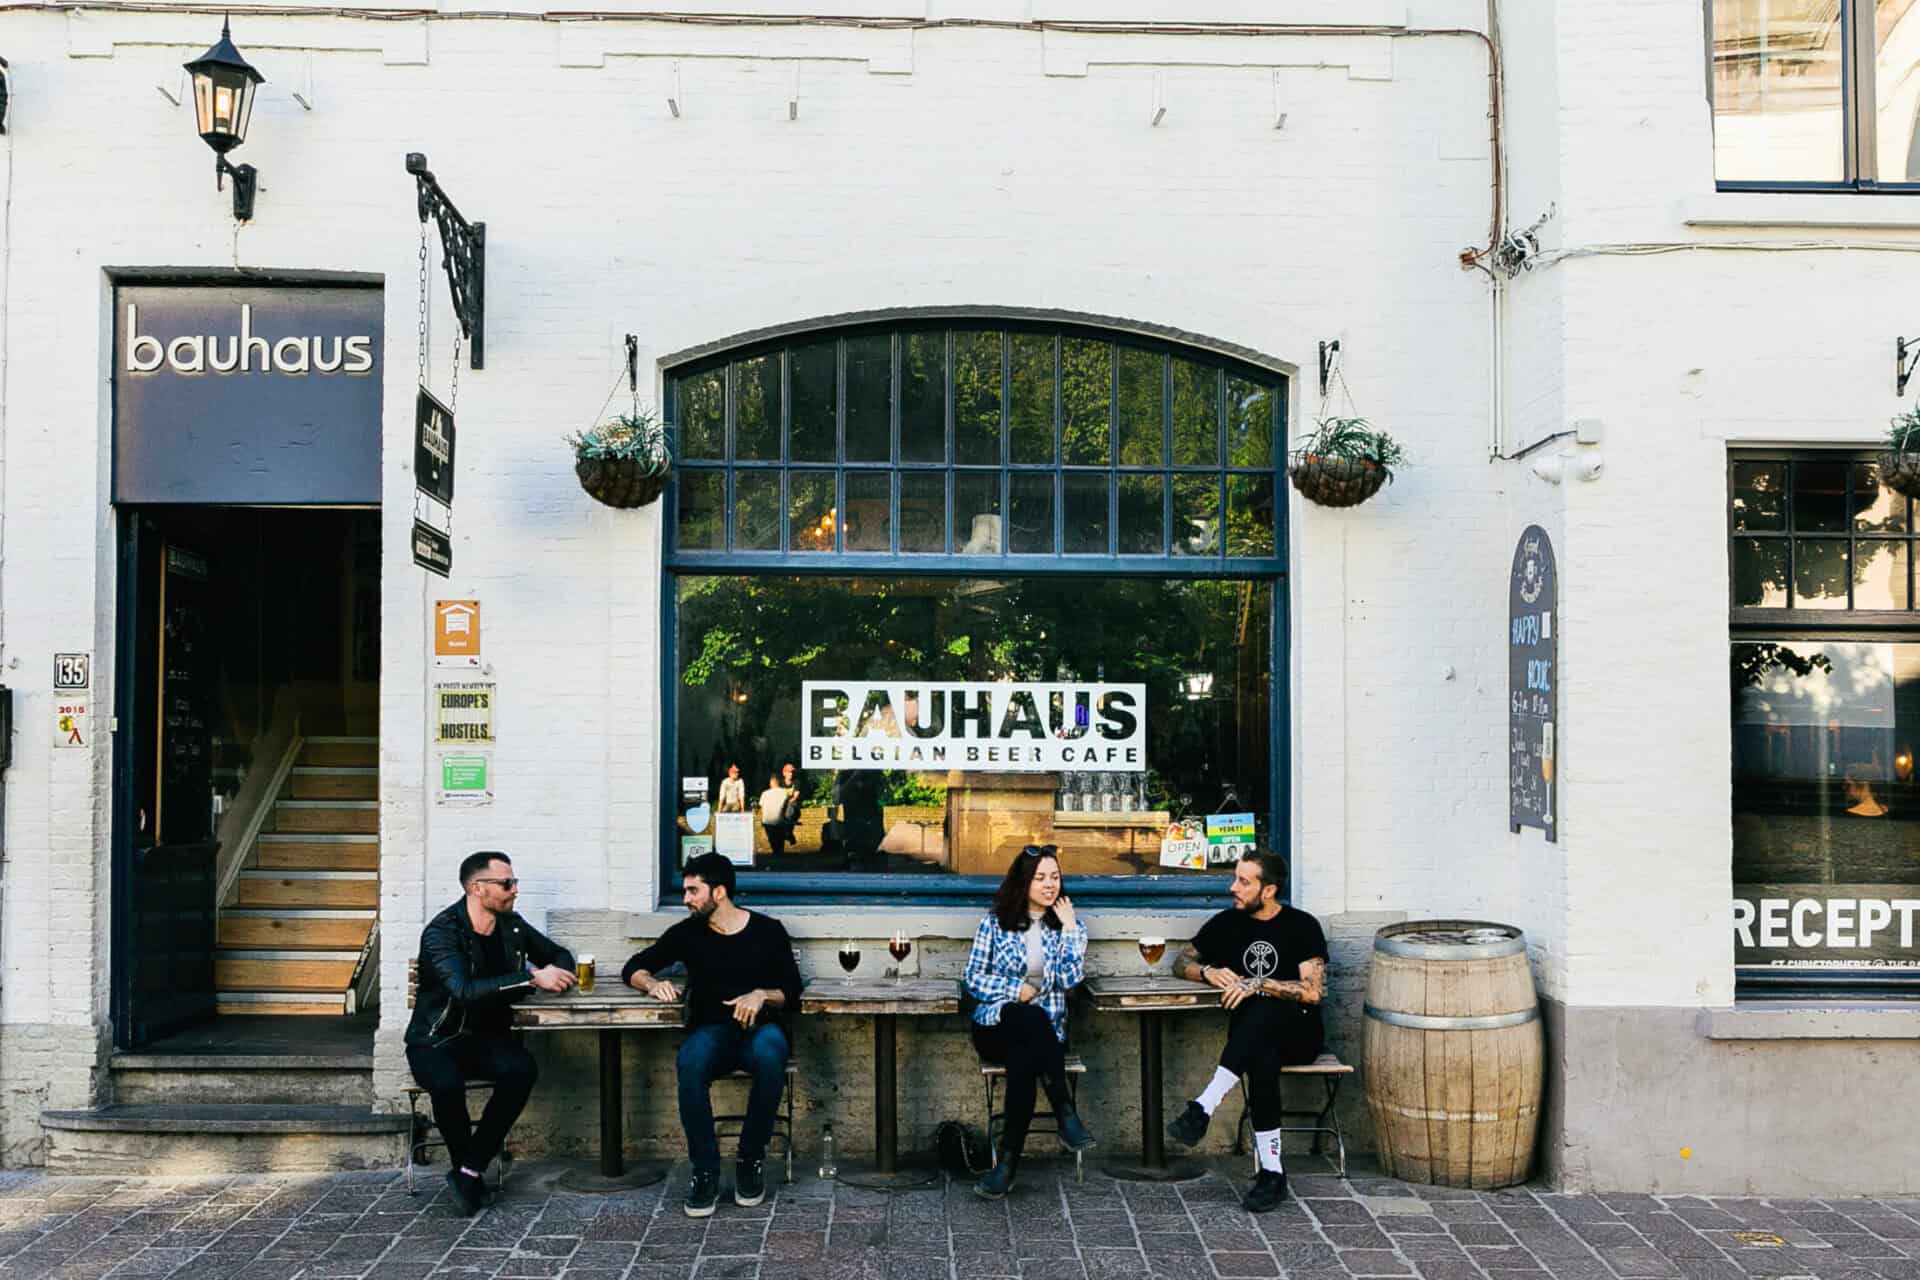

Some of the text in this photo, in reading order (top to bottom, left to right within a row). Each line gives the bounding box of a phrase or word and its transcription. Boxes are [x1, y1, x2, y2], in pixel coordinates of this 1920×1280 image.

[127, 303, 373, 372] bauhaus
[56, 658, 84, 684] 135
[441, 694, 489, 709] EUROPE'S
[811, 689, 1137, 741] BAUHAUS
[441, 723, 488, 740] HOSTELS
[810, 745, 1137, 763] BELGIAN BEER CAFE
[1167, 840, 1201, 853] OPEN
[1733, 898, 1920, 948] RECEPT
